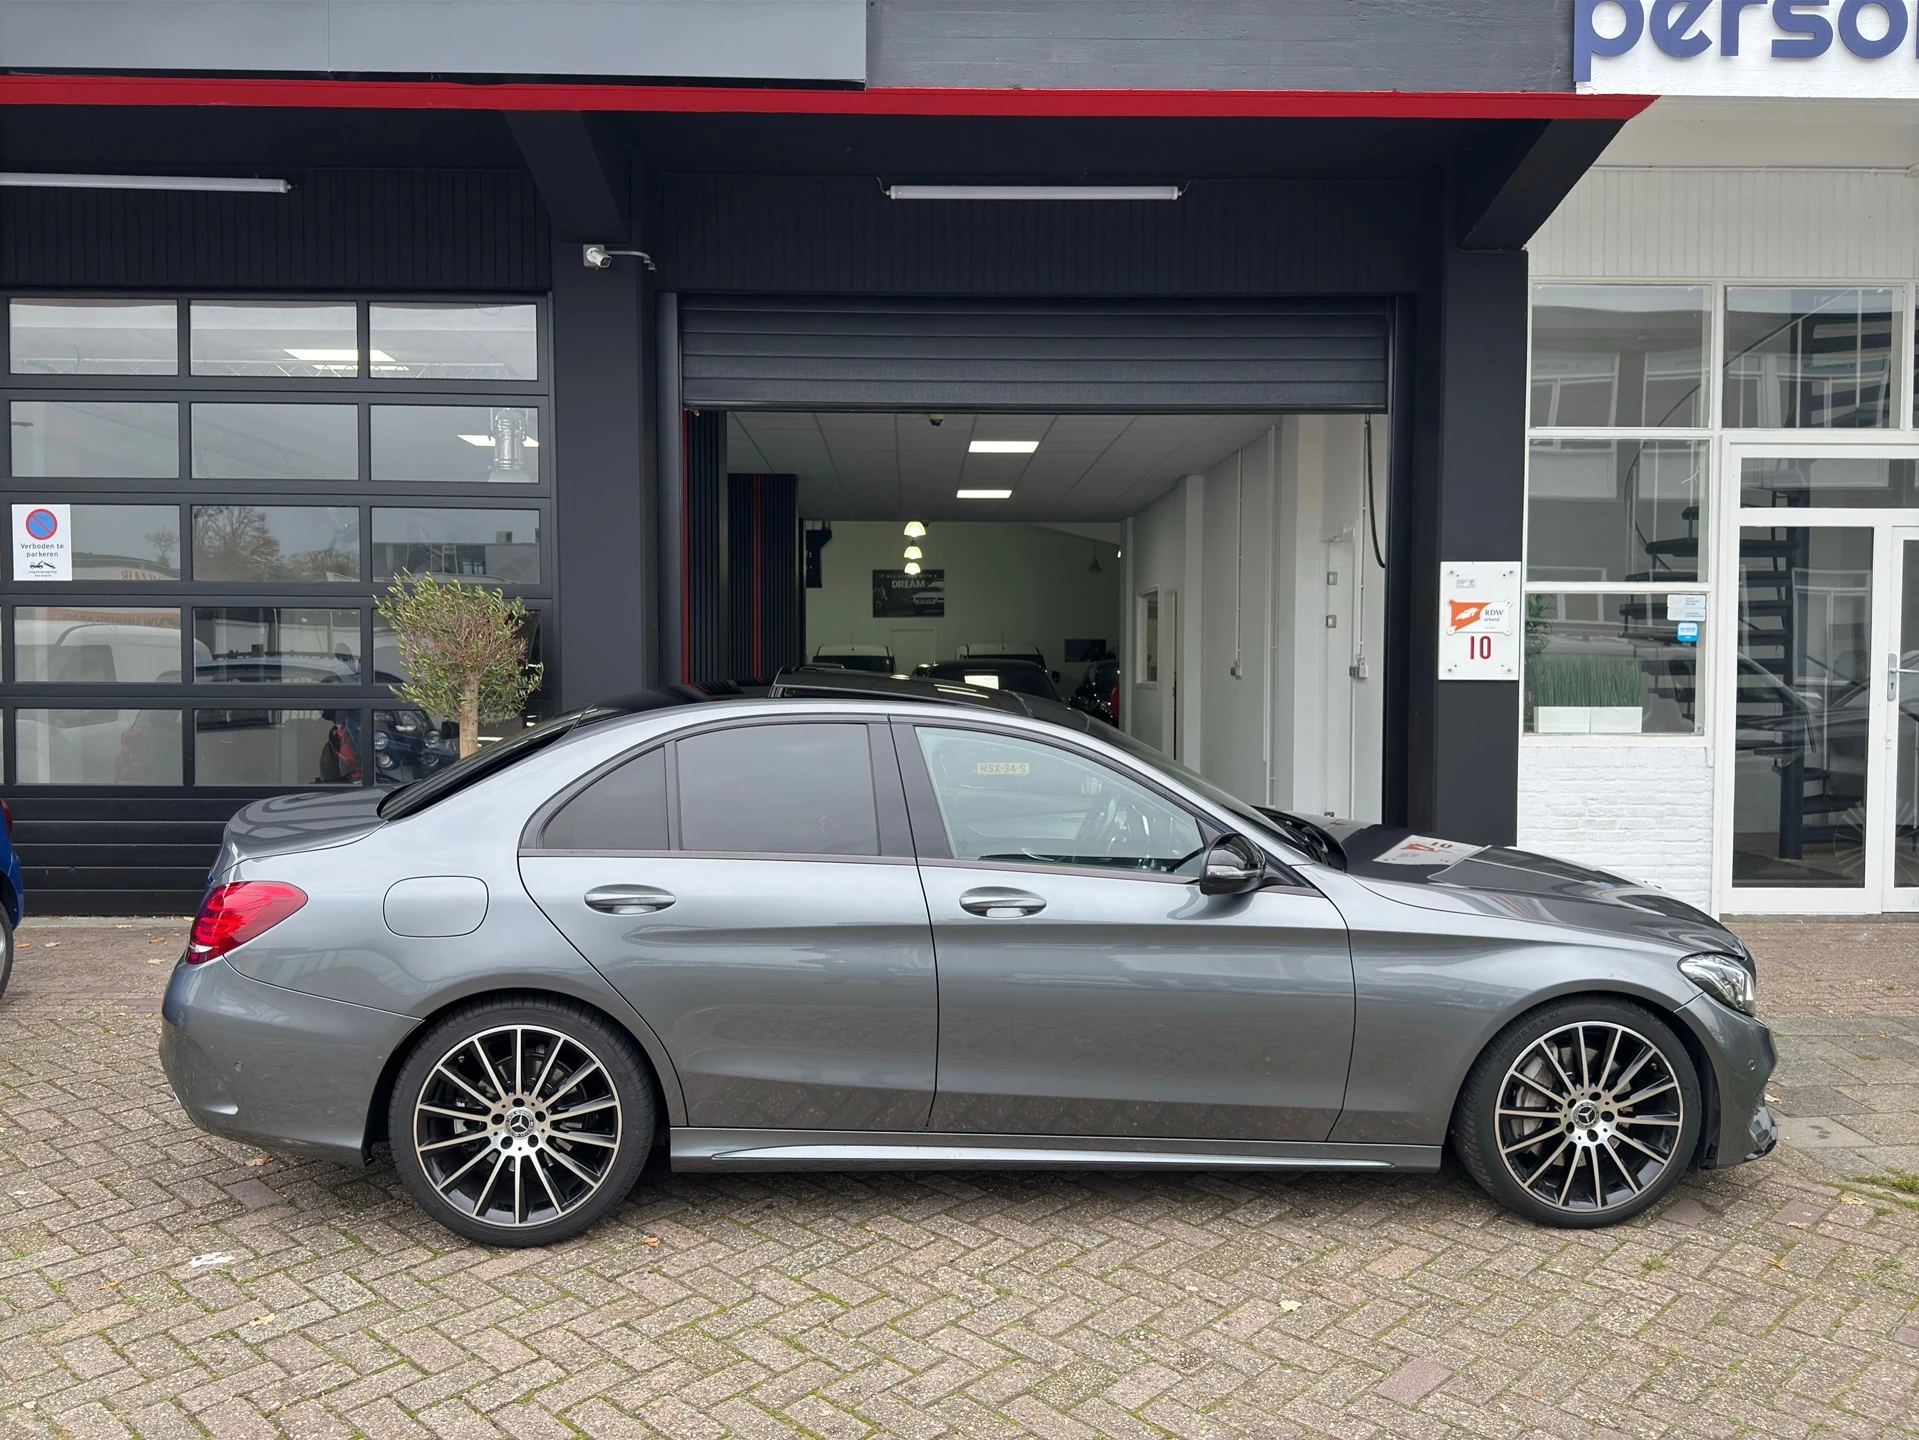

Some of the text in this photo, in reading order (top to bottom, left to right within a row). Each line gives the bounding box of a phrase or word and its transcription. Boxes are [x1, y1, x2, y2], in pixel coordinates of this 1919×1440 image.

[1574, 0, 1919, 82] perso
[891, 579, 926, 589] DREAM
[1484, 609, 1504, 617] RDW
[1470, 635, 1492, 660] 10
[980, 763, 1026, 774] HSX-34-S
